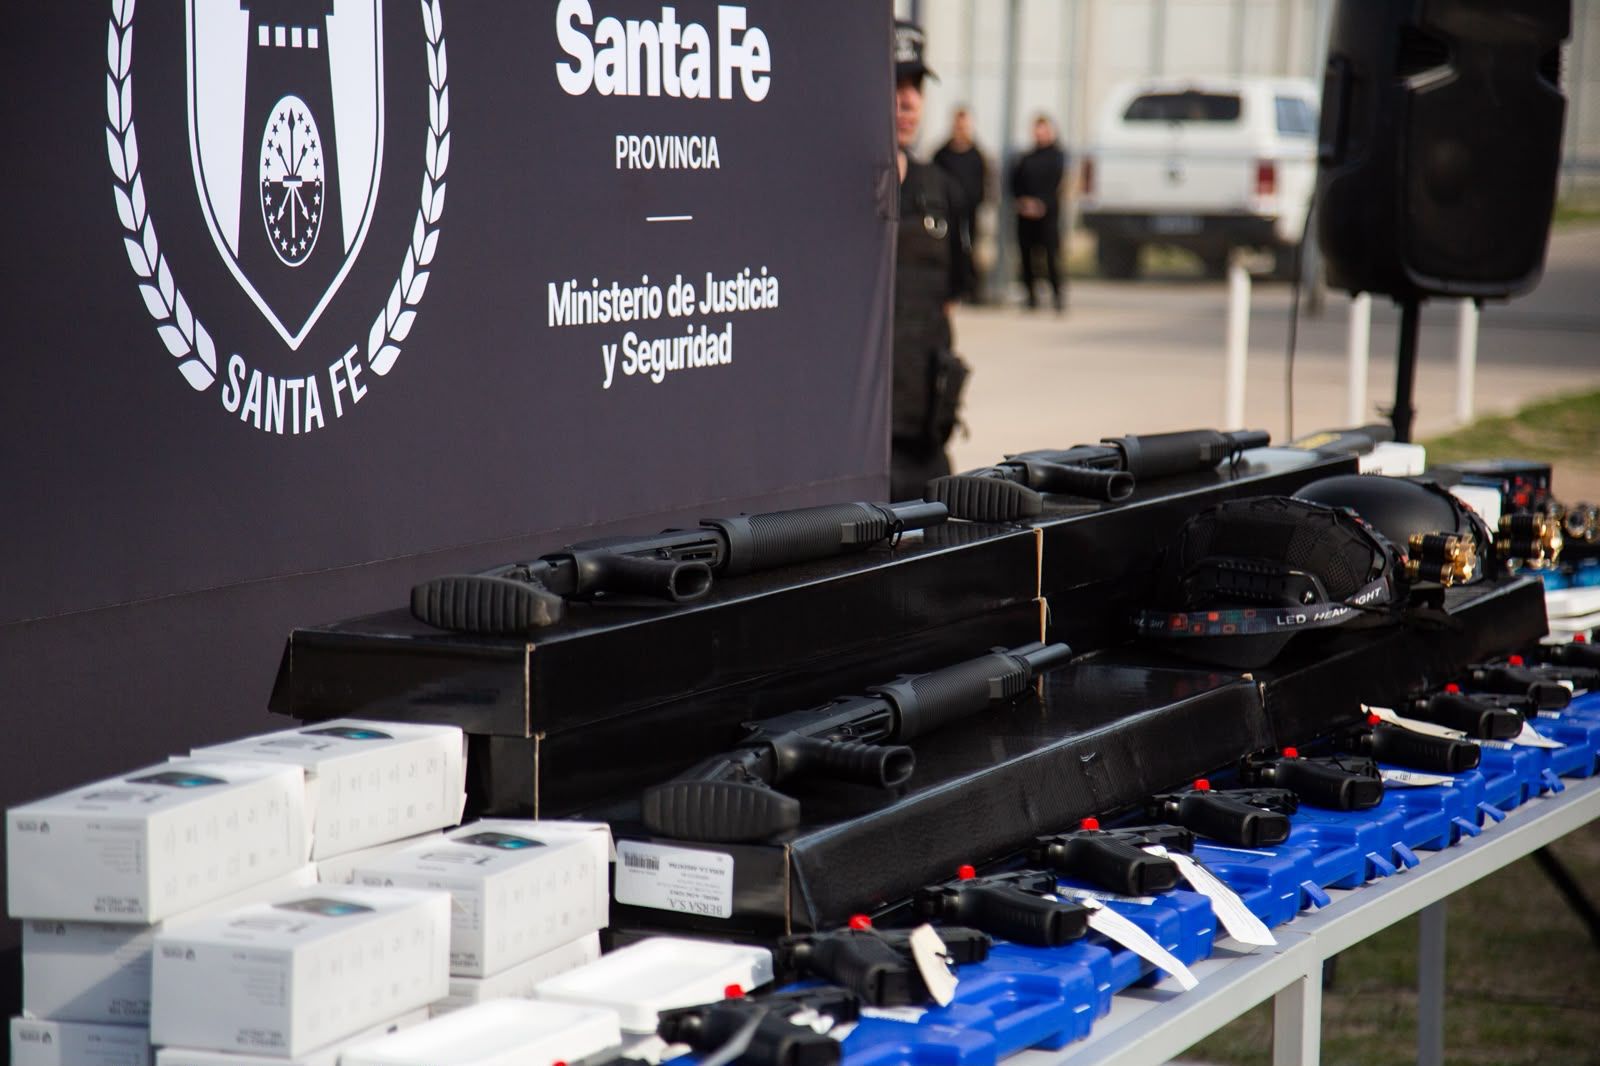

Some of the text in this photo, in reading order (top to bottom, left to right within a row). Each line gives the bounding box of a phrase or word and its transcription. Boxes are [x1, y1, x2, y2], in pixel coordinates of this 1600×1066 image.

[556, 0, 771, 102] Santa Fe
[615, 134, 720, 170] PROVINCIA
[548, 265, 779, 328] Ministerio de Justicia
[601, 322, 733, 390] y Seguridad
[221, 344, 368, 435] SANTA FE
[1277, 614, 1306, 625] LED
[688, 901, 723, 916] BERSA
